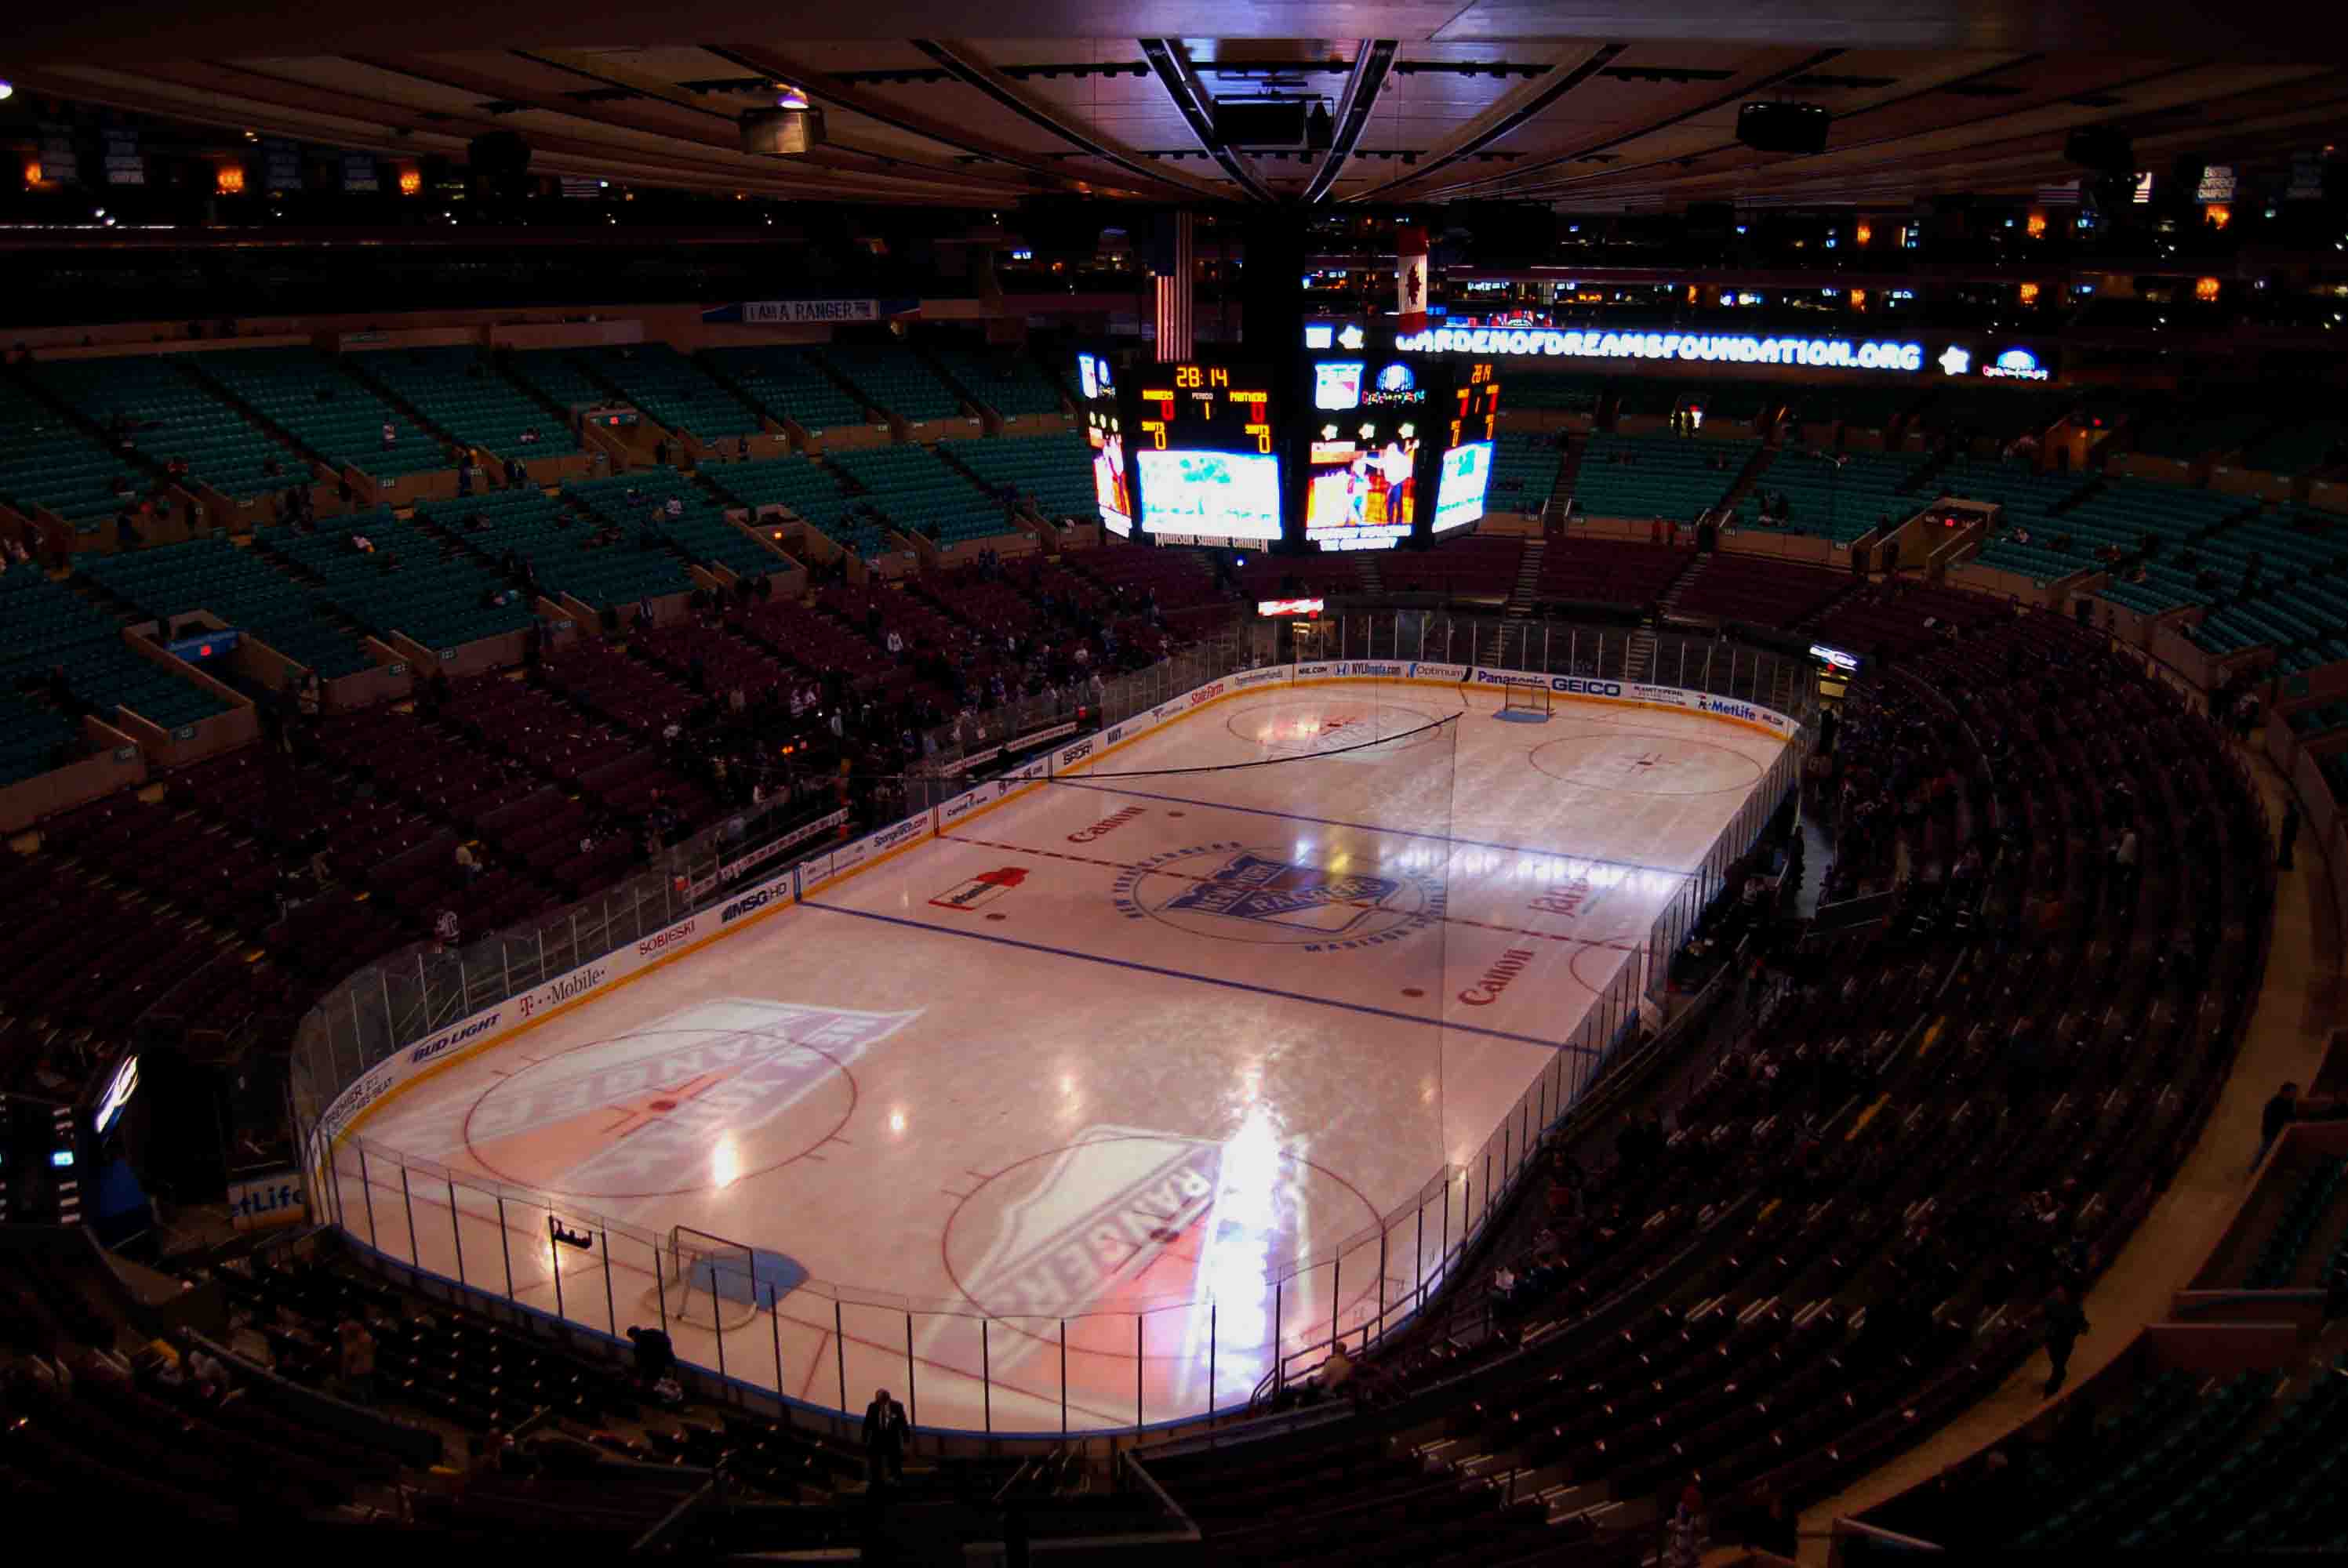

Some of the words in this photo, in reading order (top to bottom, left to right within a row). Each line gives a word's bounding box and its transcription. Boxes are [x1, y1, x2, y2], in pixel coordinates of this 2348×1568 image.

[796, 300, 853, 321] RANGER
[1176, 366, 1228, 388] 28:14
[1552, 677, 1621, 697] GEICO
[1710, 699, 1757, 722] MetLife
[1067, 807, 1147, 843] Canon
[639, 919, 696, 955] SOBIESKI
[411, 1040, 448, 1062] BUD
[450, 1014, 501, 1044] LIGHT
